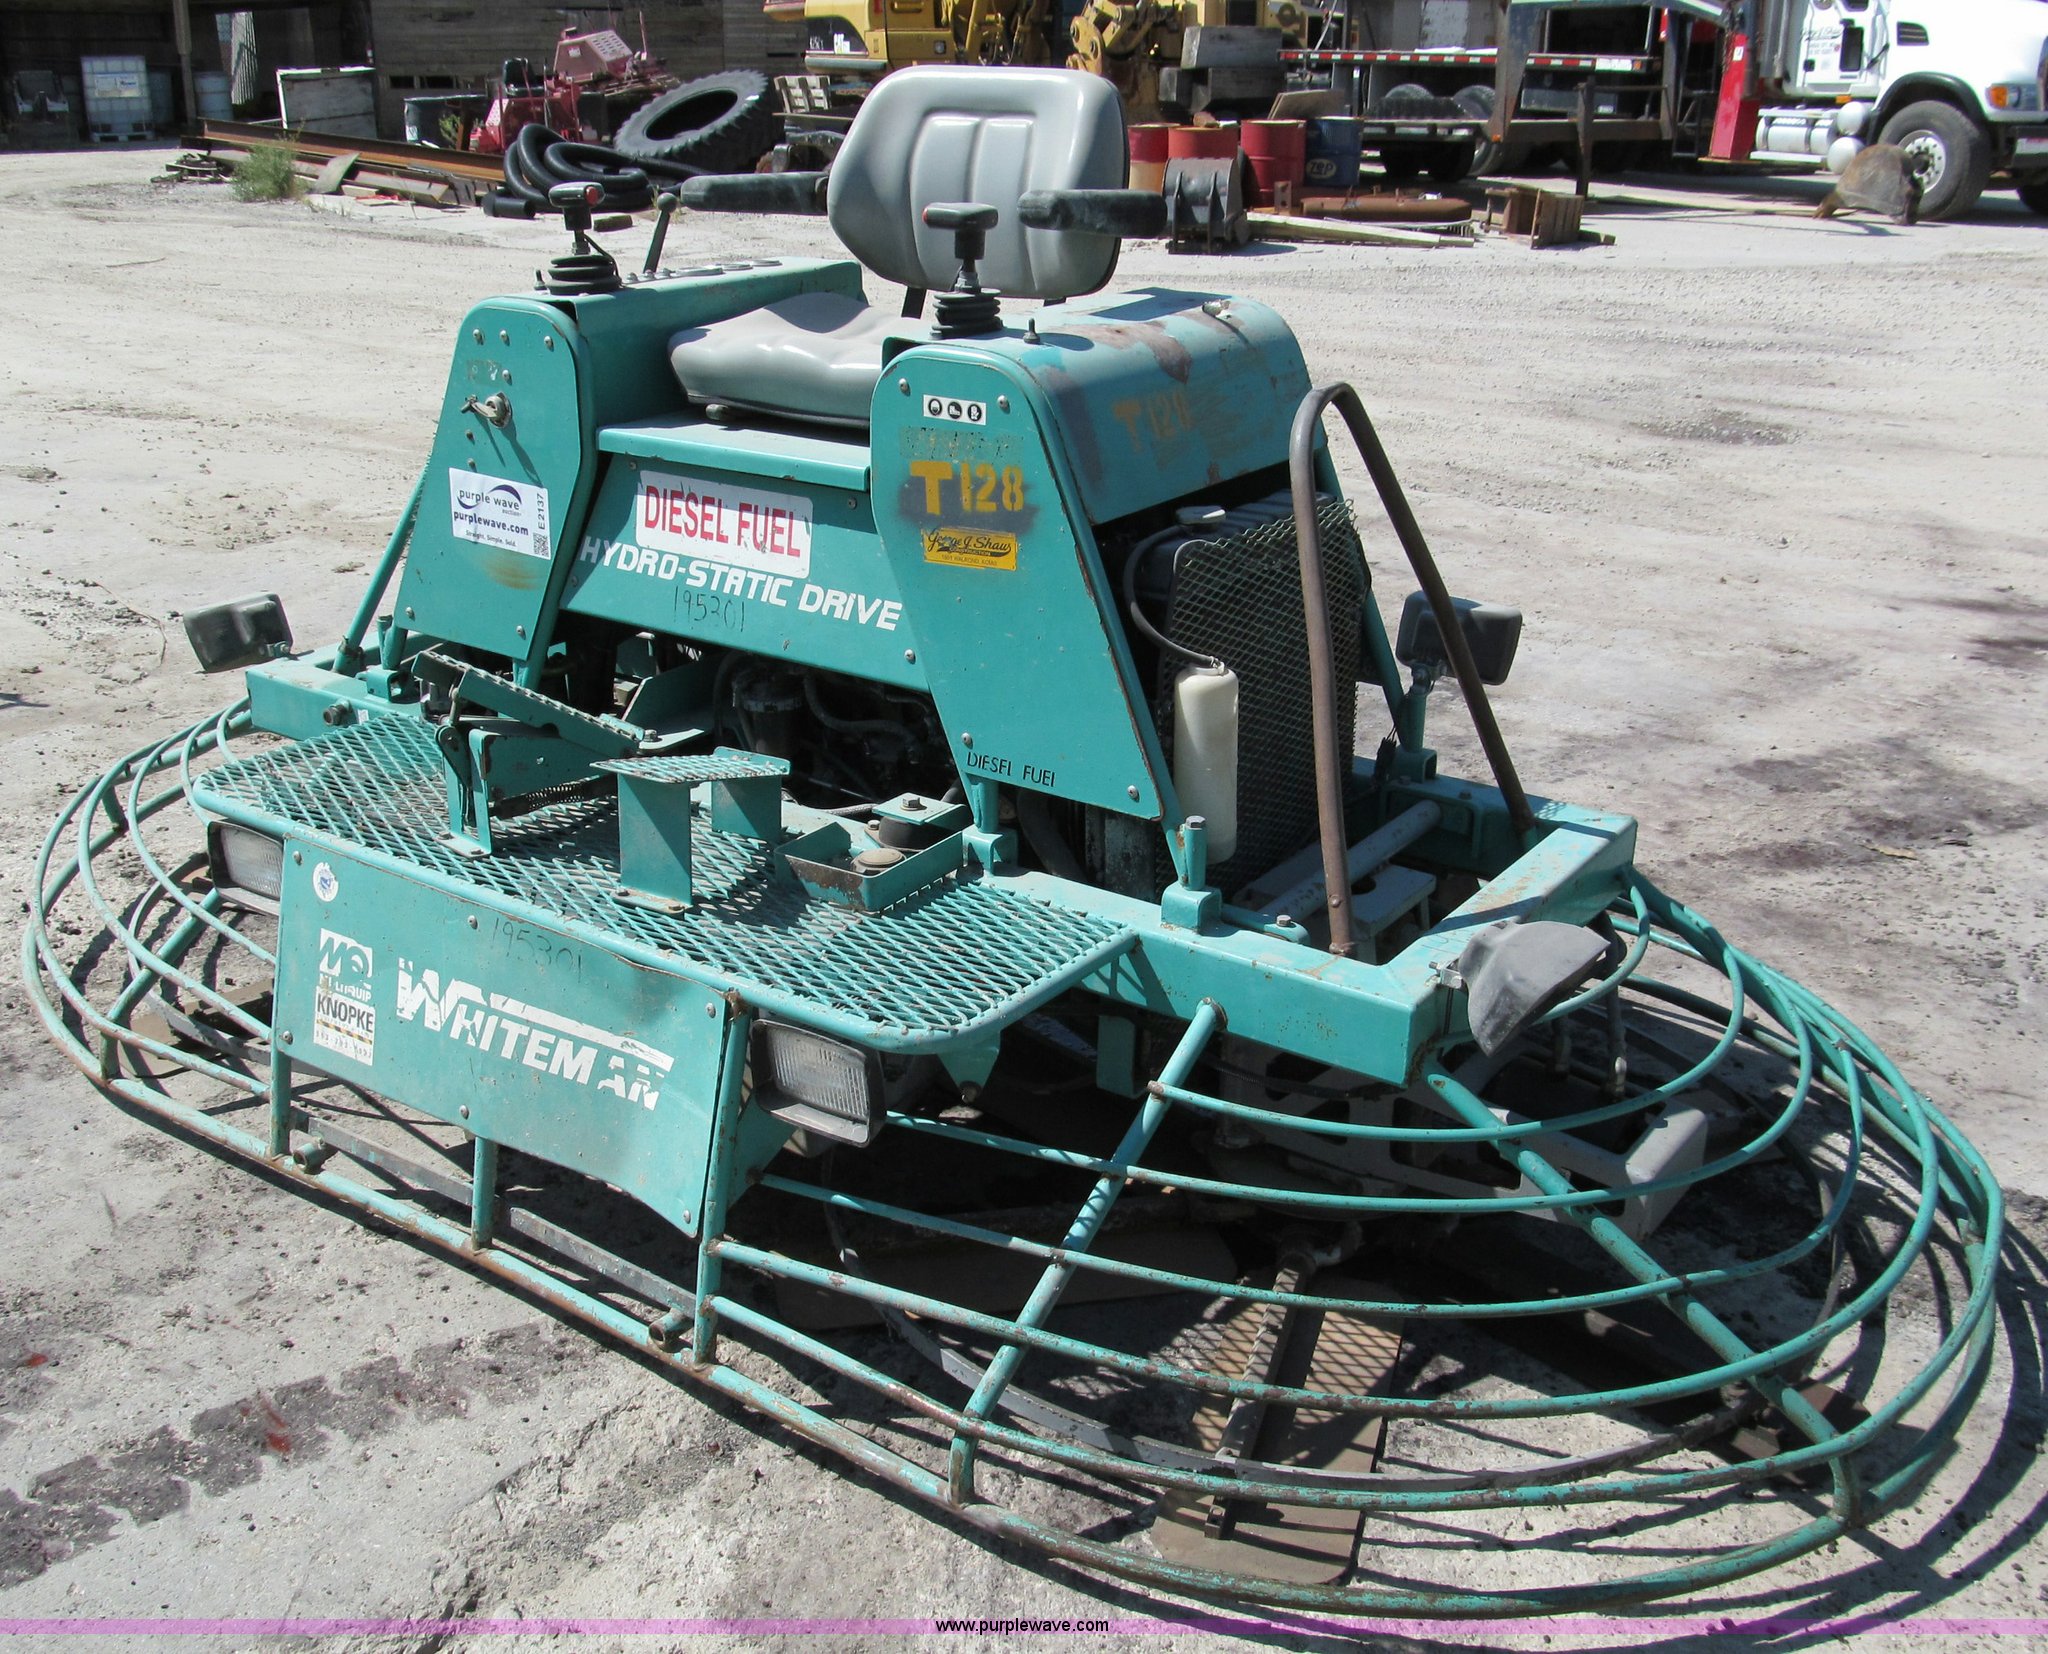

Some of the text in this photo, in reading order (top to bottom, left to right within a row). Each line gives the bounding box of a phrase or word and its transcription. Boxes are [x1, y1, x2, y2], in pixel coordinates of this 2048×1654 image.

[459, 489, 520, 510] purple wave
[537, 493, 545, 530] E2137
[911, 459, 1025, 516] T128
[453, 511, 529, 536] purplewave.com
[644, 485, 801, 558] DIESEL FUEL
[974, 536, 1012, 551] Shaw
[579, 535, 903, 631] HYDRO-STATIC DRIVE
[492, 917, 582, 983] 195301
[317, 993, 374, 1034] KNOPKE
[396, 957, 672, 1111] WHITEMAN
